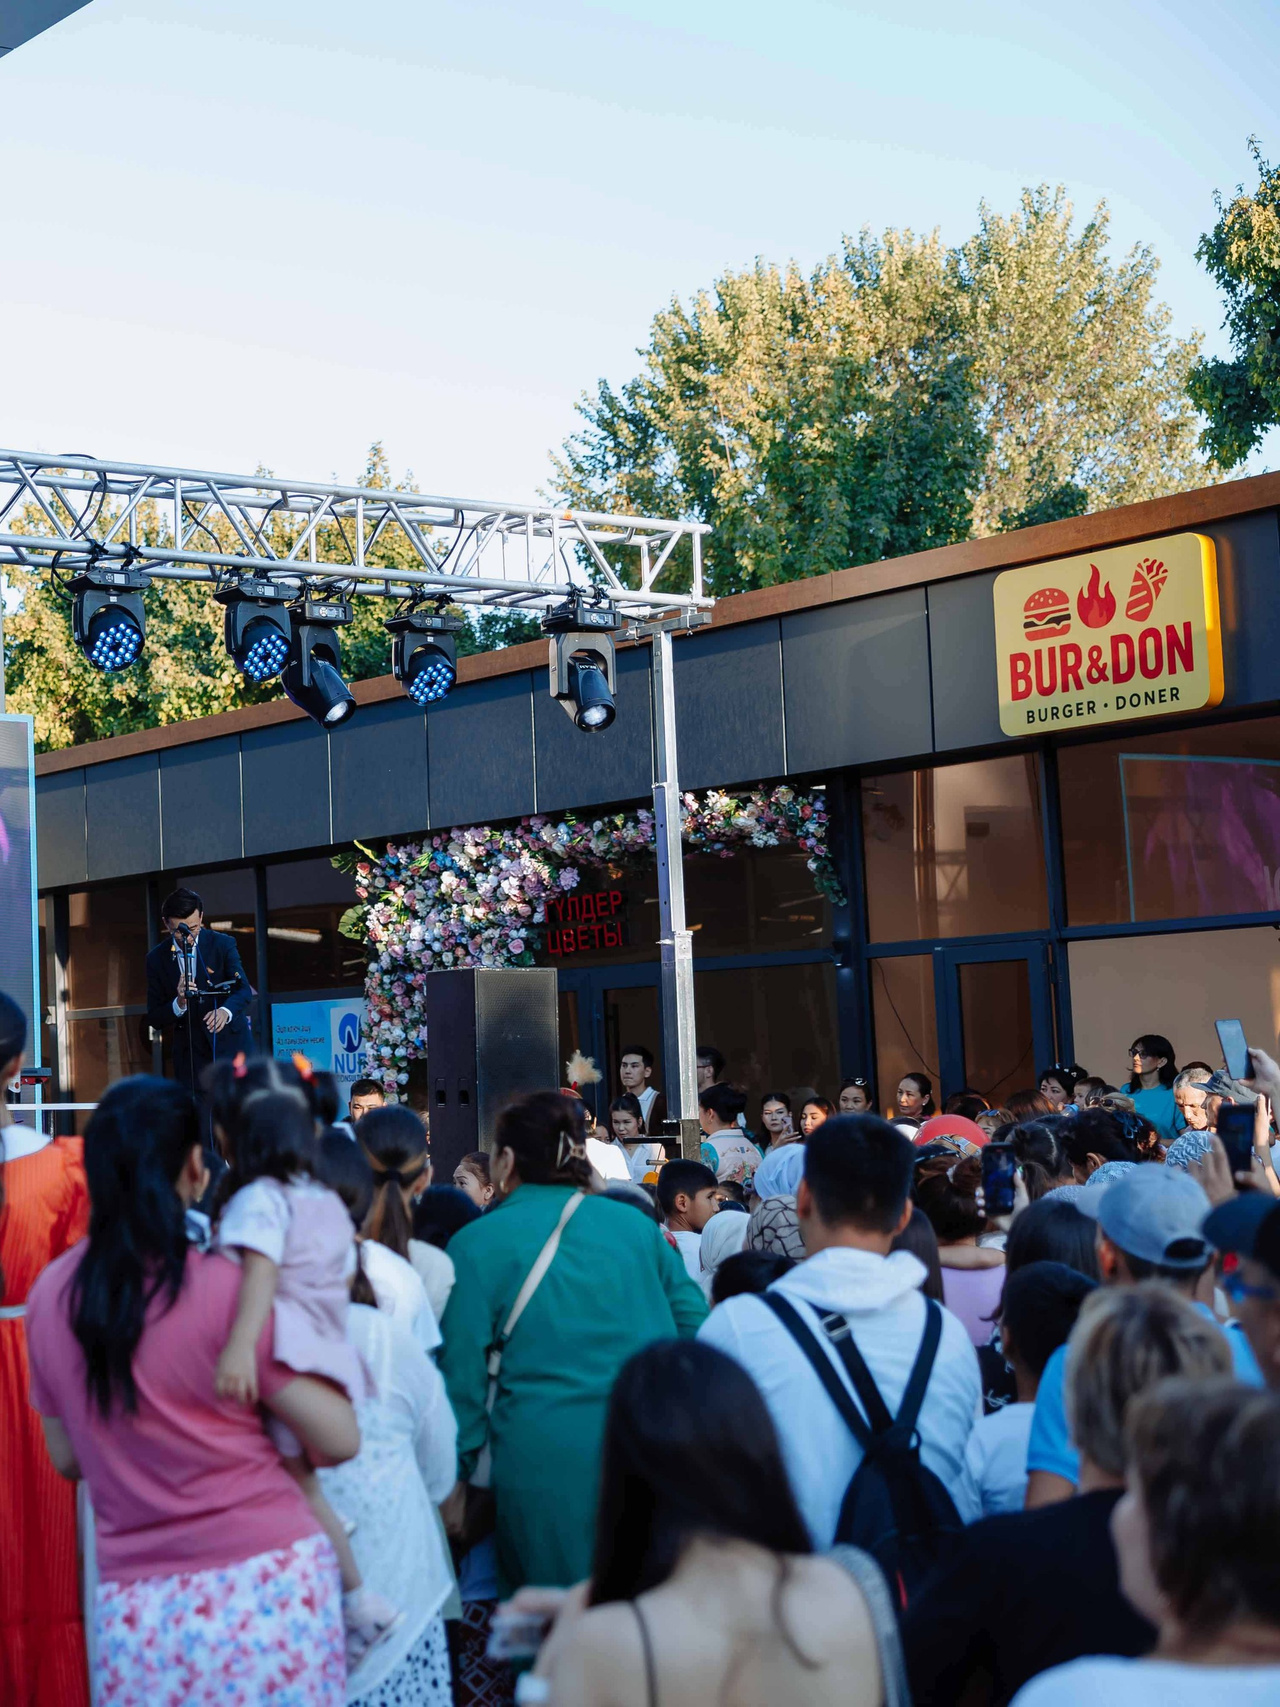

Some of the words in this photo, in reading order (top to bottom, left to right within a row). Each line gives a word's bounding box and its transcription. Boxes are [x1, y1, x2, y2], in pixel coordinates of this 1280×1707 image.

[1009, 621, 1195, 702] BUR&DON
[1026, 700, 1097, 725] BURGER
[1115, 687, 1181, 711] DONER
[547, 921, 623, 957] ЦВЕТЫ
